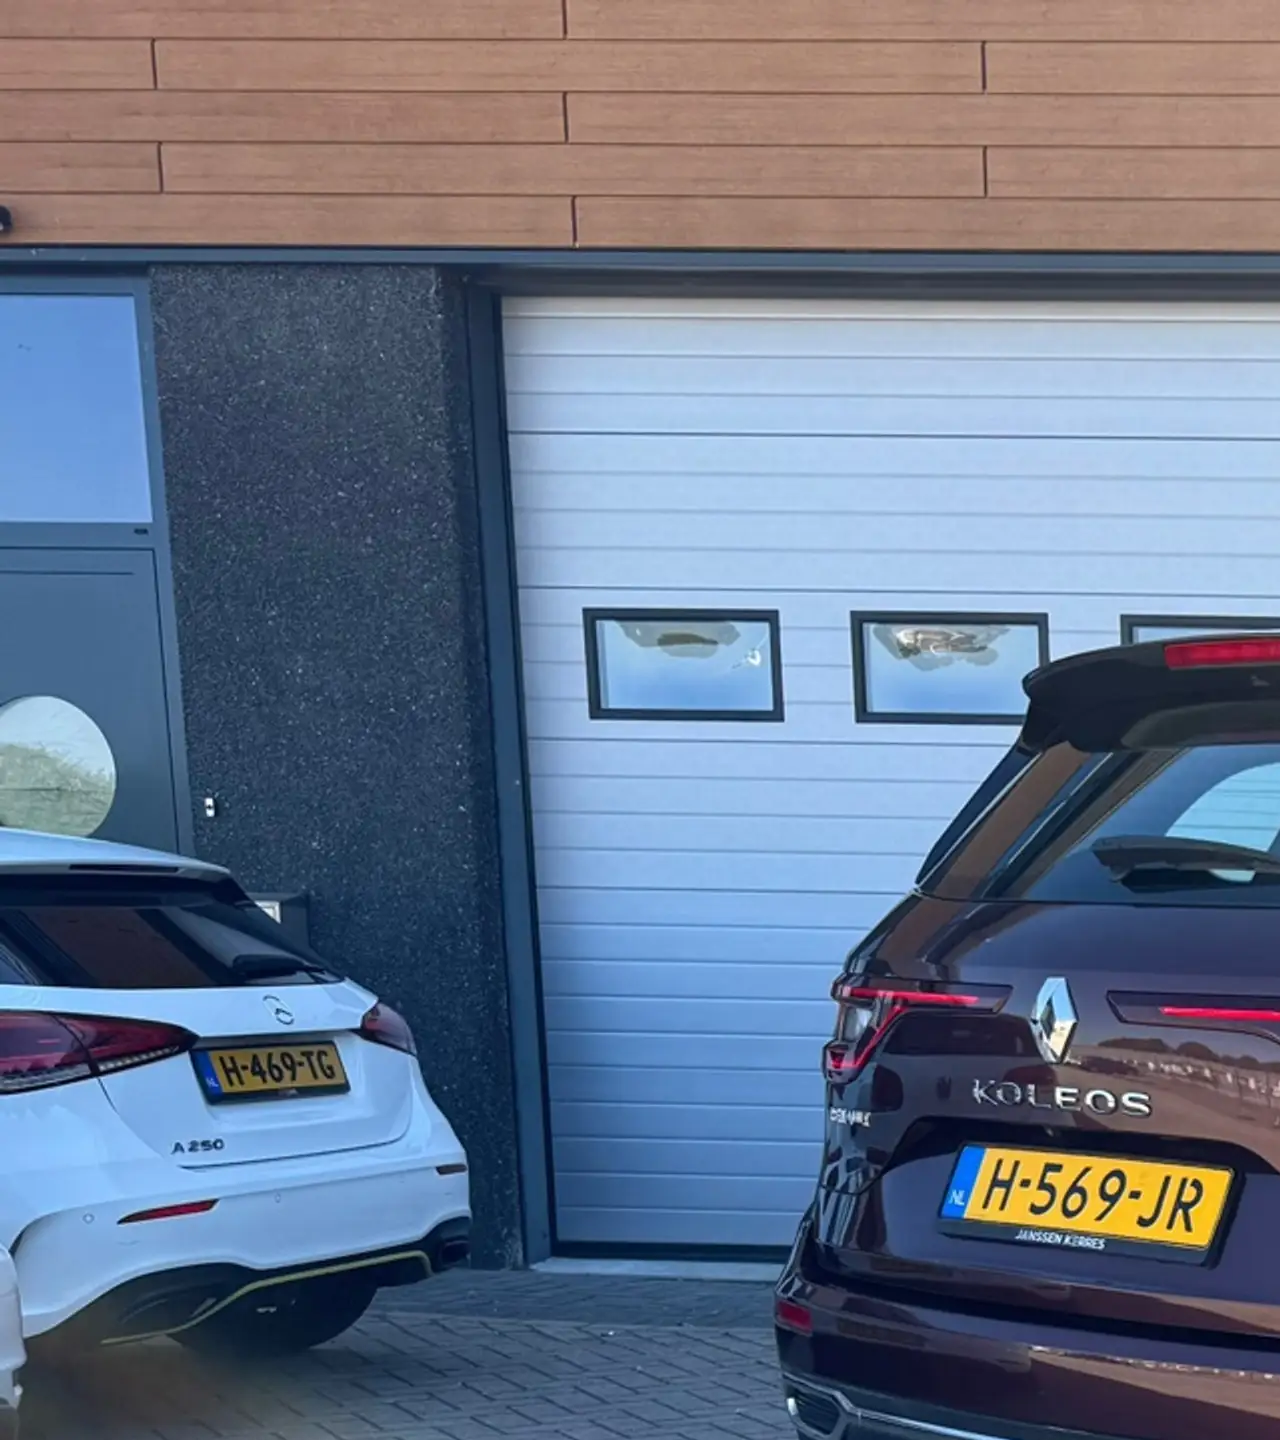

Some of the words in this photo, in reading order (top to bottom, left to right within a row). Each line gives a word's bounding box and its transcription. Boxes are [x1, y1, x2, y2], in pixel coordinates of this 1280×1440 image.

[218, 1050, 336, 1087] H-469-TG
[972, 1078, 1153, 1117] KOLEOS
[172, 1142, 185, 1154] A
[188, 1138, 225, 1151] 250
[948, 1189, 966, 1206] NL
[981, 1157, 1205, 1233] H-569-JR
[1015, 1228, 1063, 1244] JANSSEN
